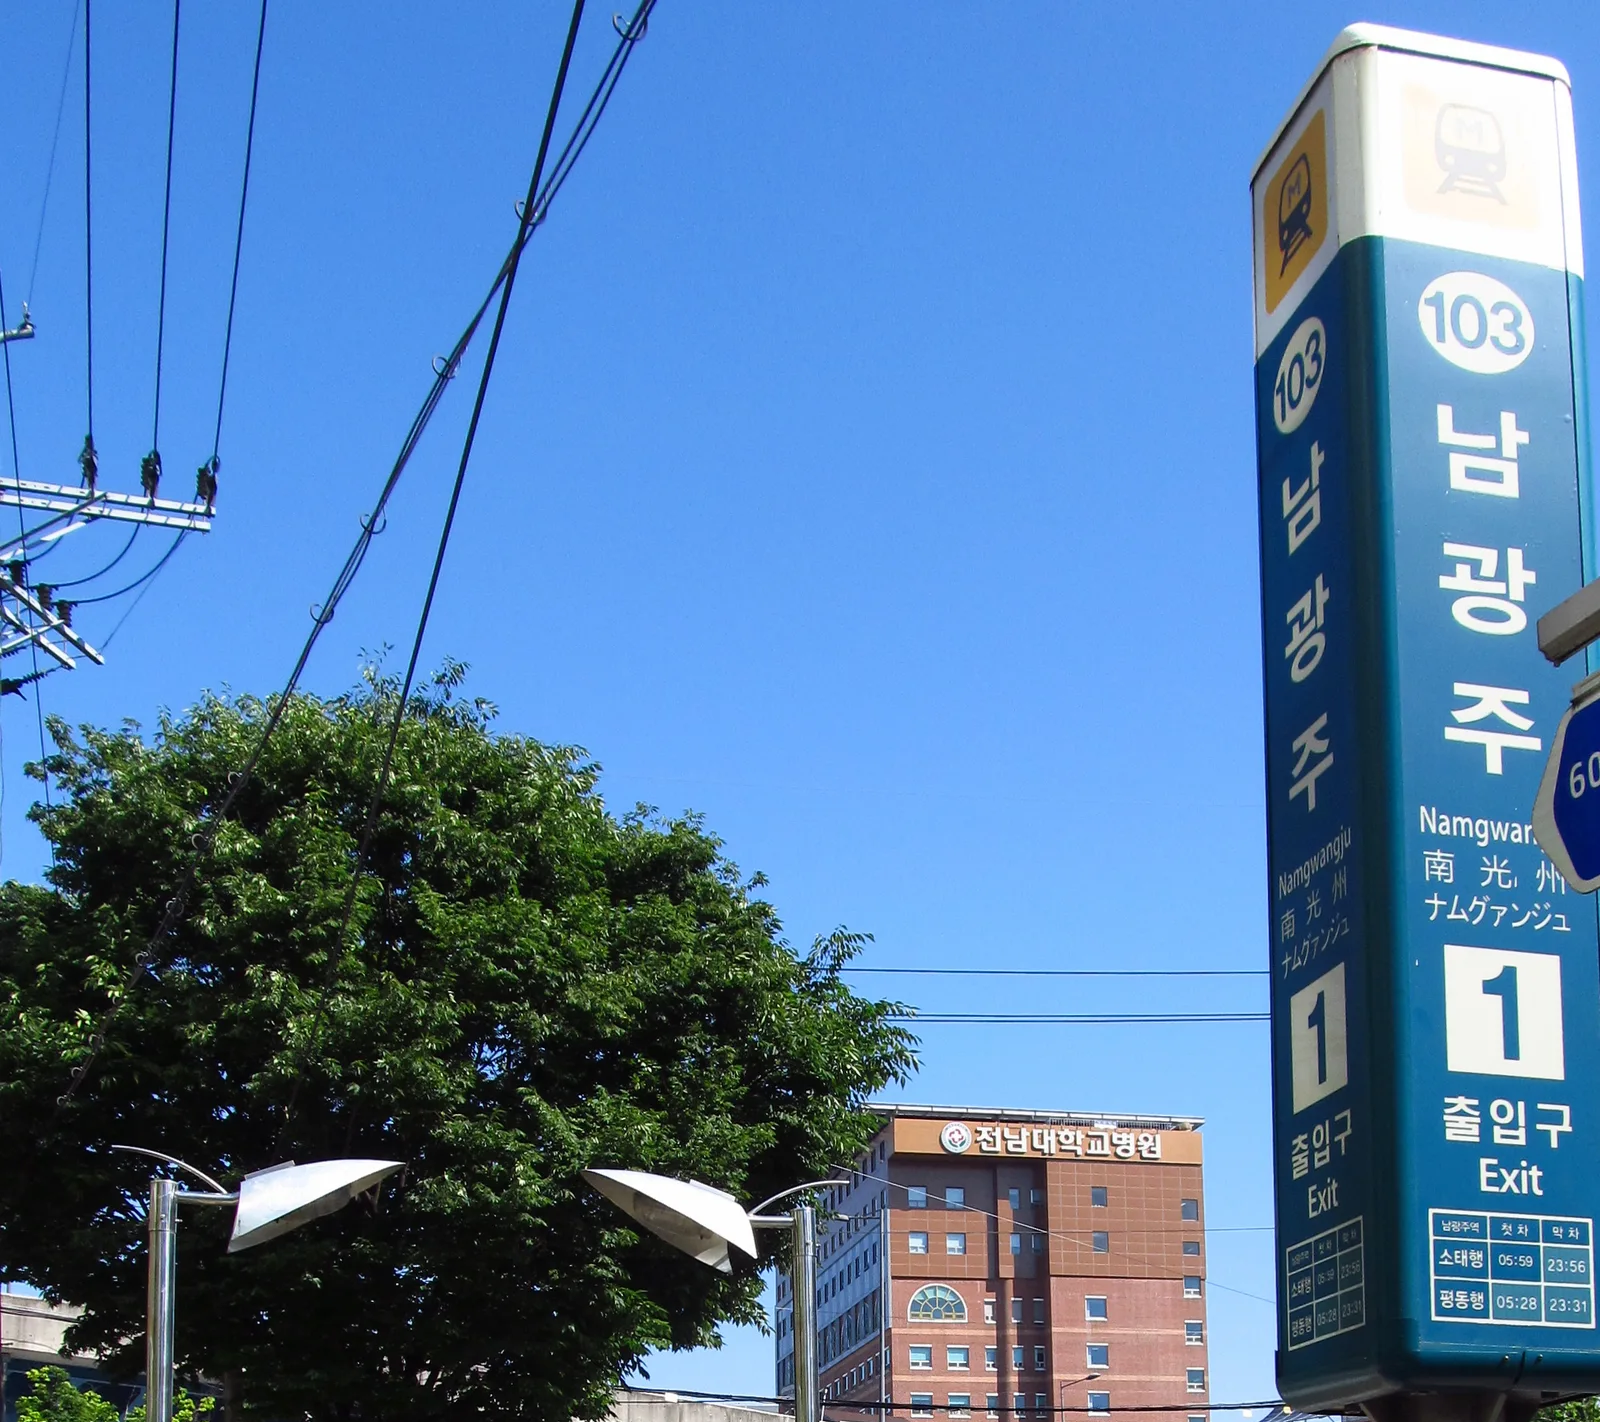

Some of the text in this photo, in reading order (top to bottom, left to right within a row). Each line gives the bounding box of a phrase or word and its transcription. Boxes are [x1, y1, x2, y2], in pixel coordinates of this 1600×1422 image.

[1424, 291, 1525, 355] 103
[1276, 329, 1322, 424] 103
[1437, 403, 1541, 775] 남광주
[1282, 440, 1334, 813] 남광주
[1420, 805, 1539, 847] Namgwan
[1278, 825, 1351, 900] Namgwangju
[1280, 866, 1347, 943] 南光州
[1424, 892, 1571, 932] ナムグァンジュ
[1281, 912, 1350, 979] ナムグァンジュ
[1308, 990, 1327, 1085] 1
[1482, 965, 1521, 1061] 1
[975, 1125, 1162, 1160] 전남대학교병원
[1291, 1108, 1352, 1181] 출입구
[1443, 1096, 1573, 1149] 출입구
[1308, 1176, 1338, 1218] Exit
[1480, 1157, 1543, 1197] Exit
[1441, 1219, 1480, 1233] 남광주역
[1291, 1275, 1311, 1298] 소태행
[1439, 1248, 1586, 1273] 소태행 05:59 23:56
[1317, 1308, 1337, 1327] 05:28
[1440, 1289, 1587, 1313] 평동행 05:28 23:31
